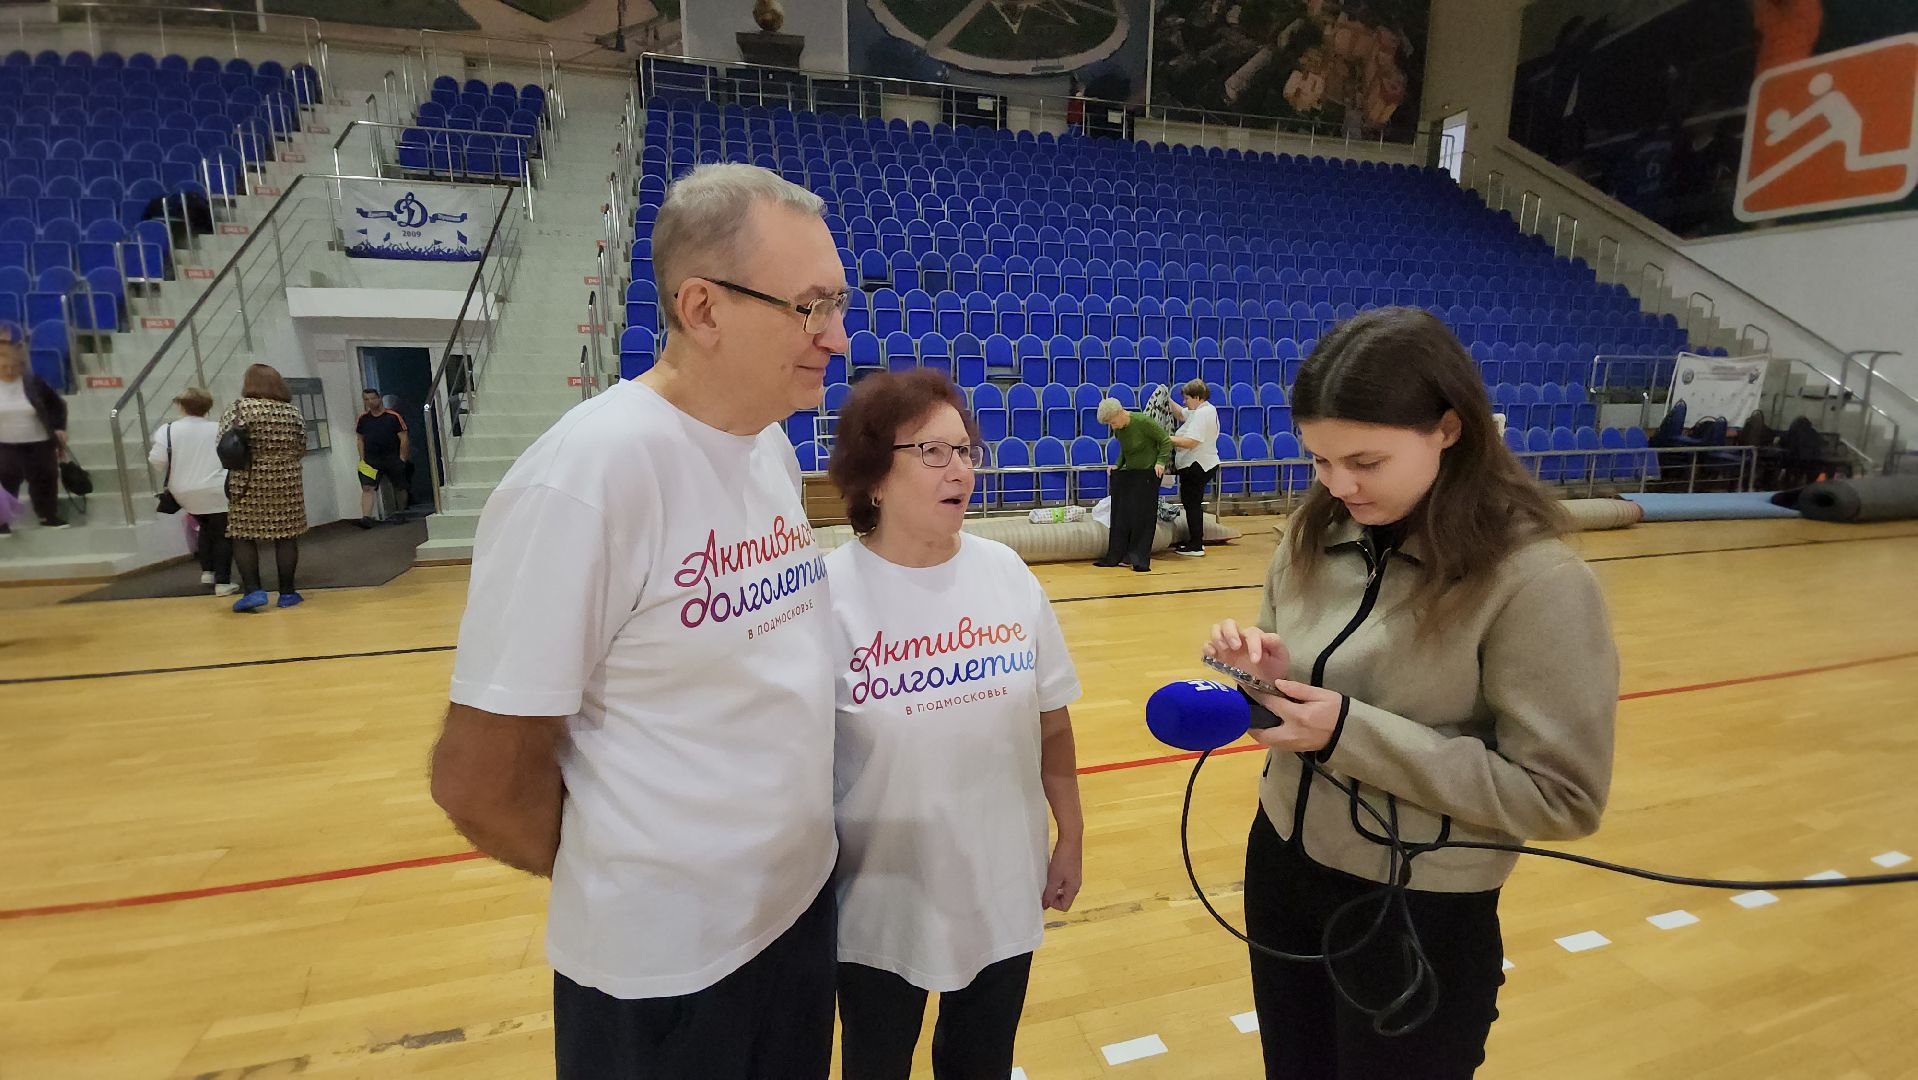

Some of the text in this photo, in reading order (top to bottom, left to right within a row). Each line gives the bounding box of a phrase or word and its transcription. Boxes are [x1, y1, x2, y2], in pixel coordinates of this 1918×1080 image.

[402, 229, 422, 238] 2009
[680, 554, 828, 629] долголети
[757, 599, 814, 636] ПОДМОСКОВЬЕ
[850, 616, 1027, 673] Активное
[852, 650, 1035, 705] долголетие
[917, 686, 1008, 713] ПОДМОСКОВЬЕ
